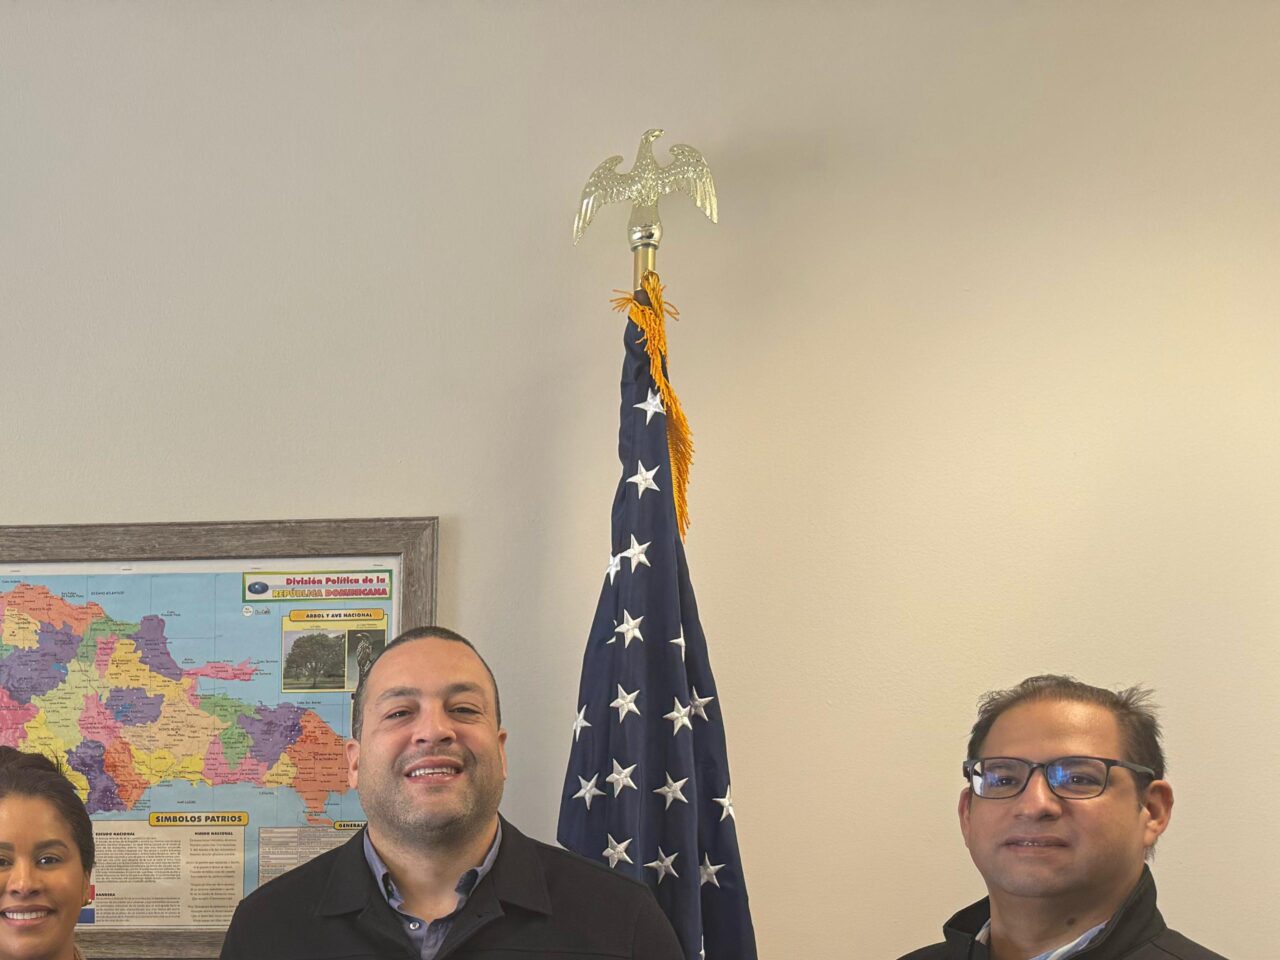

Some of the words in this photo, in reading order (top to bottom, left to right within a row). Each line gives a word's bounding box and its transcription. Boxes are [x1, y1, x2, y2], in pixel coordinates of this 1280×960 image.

[286, 577, 322, 585] División
[325, 576, 359, 585] Política
[362, 576, 374, 584] de
[376, 576, 386, 584] la
